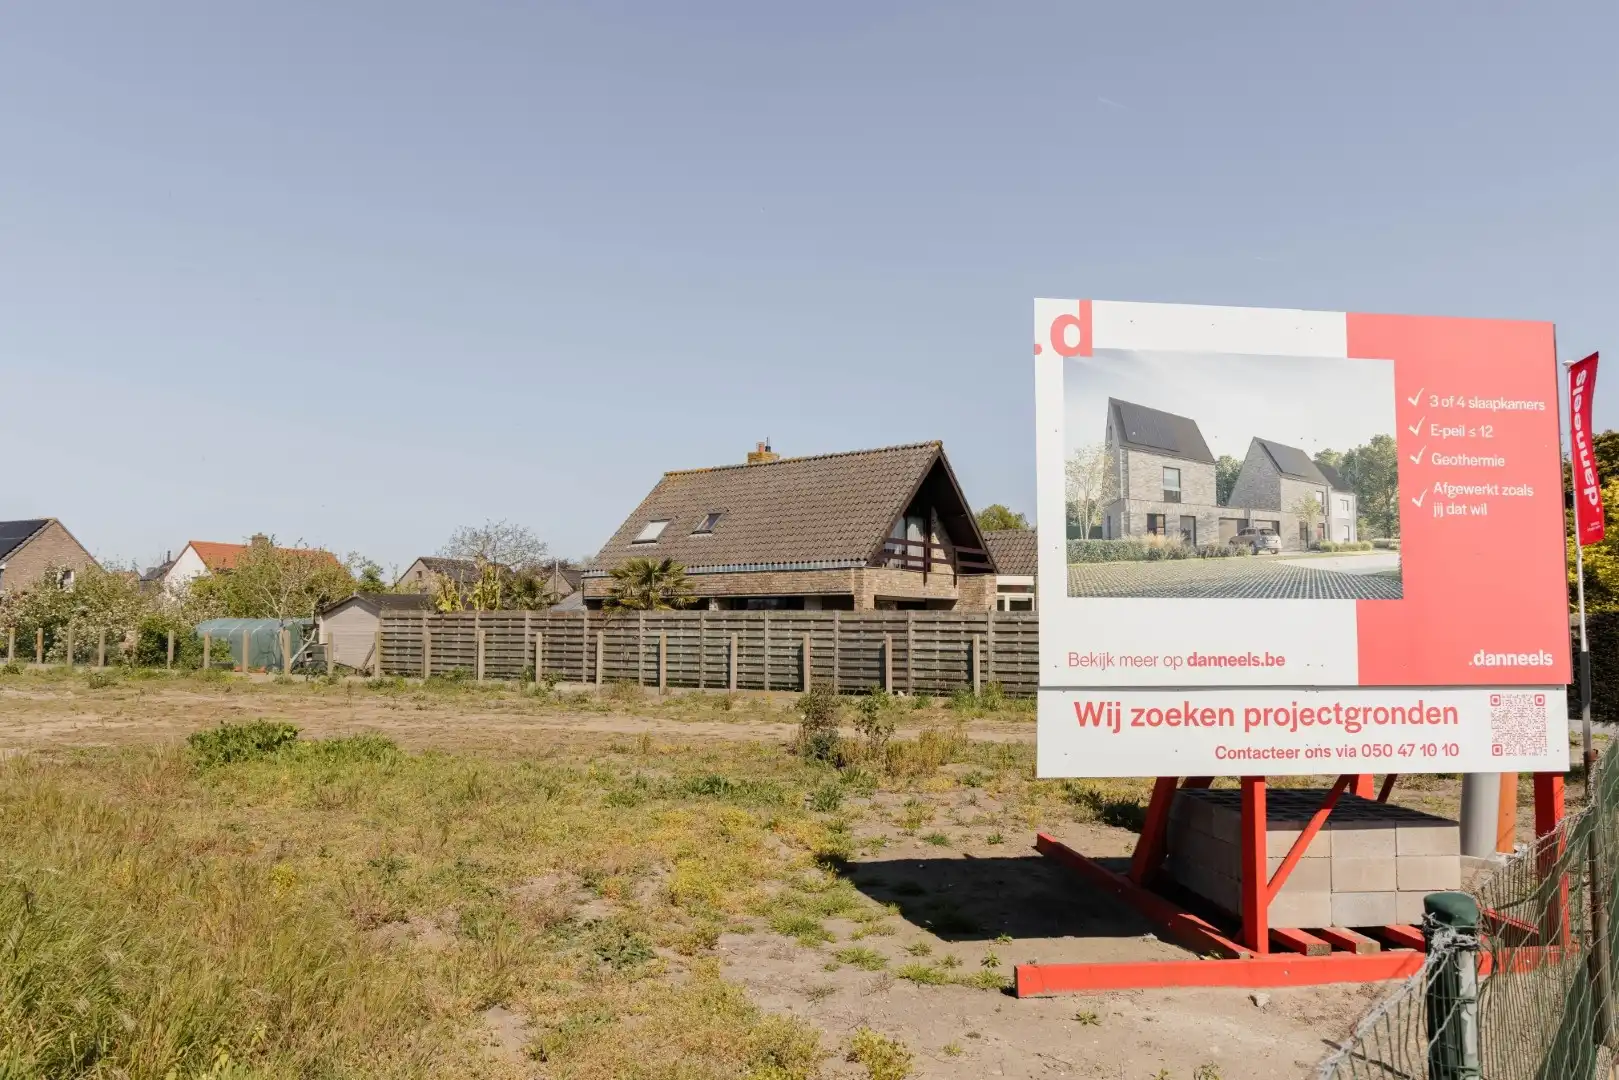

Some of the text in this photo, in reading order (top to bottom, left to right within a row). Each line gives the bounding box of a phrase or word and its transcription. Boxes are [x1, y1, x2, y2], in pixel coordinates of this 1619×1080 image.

[1429, 394, 1546, 413] 3 of 4 slaapkamers
[1430, 423, 1465, 440] E-peil
[1479, 424, 1494, 439] 12
[1431, 452, 1505, 467] Geothermie
[1433, 481, 1534, 499] Afgewerkt zoals
[1433, 502, 1488, 518] jij dat wil
[1068, 651, 1286, 671] Bekijk meer op danneels.be
[1468, 649, 1553, 666] .danneels
[1073, 699, 1459, 734] Wij zoeken projectgronden
[1215, 743, 1459, 760] Contacteer ons via 050 47 10 10
